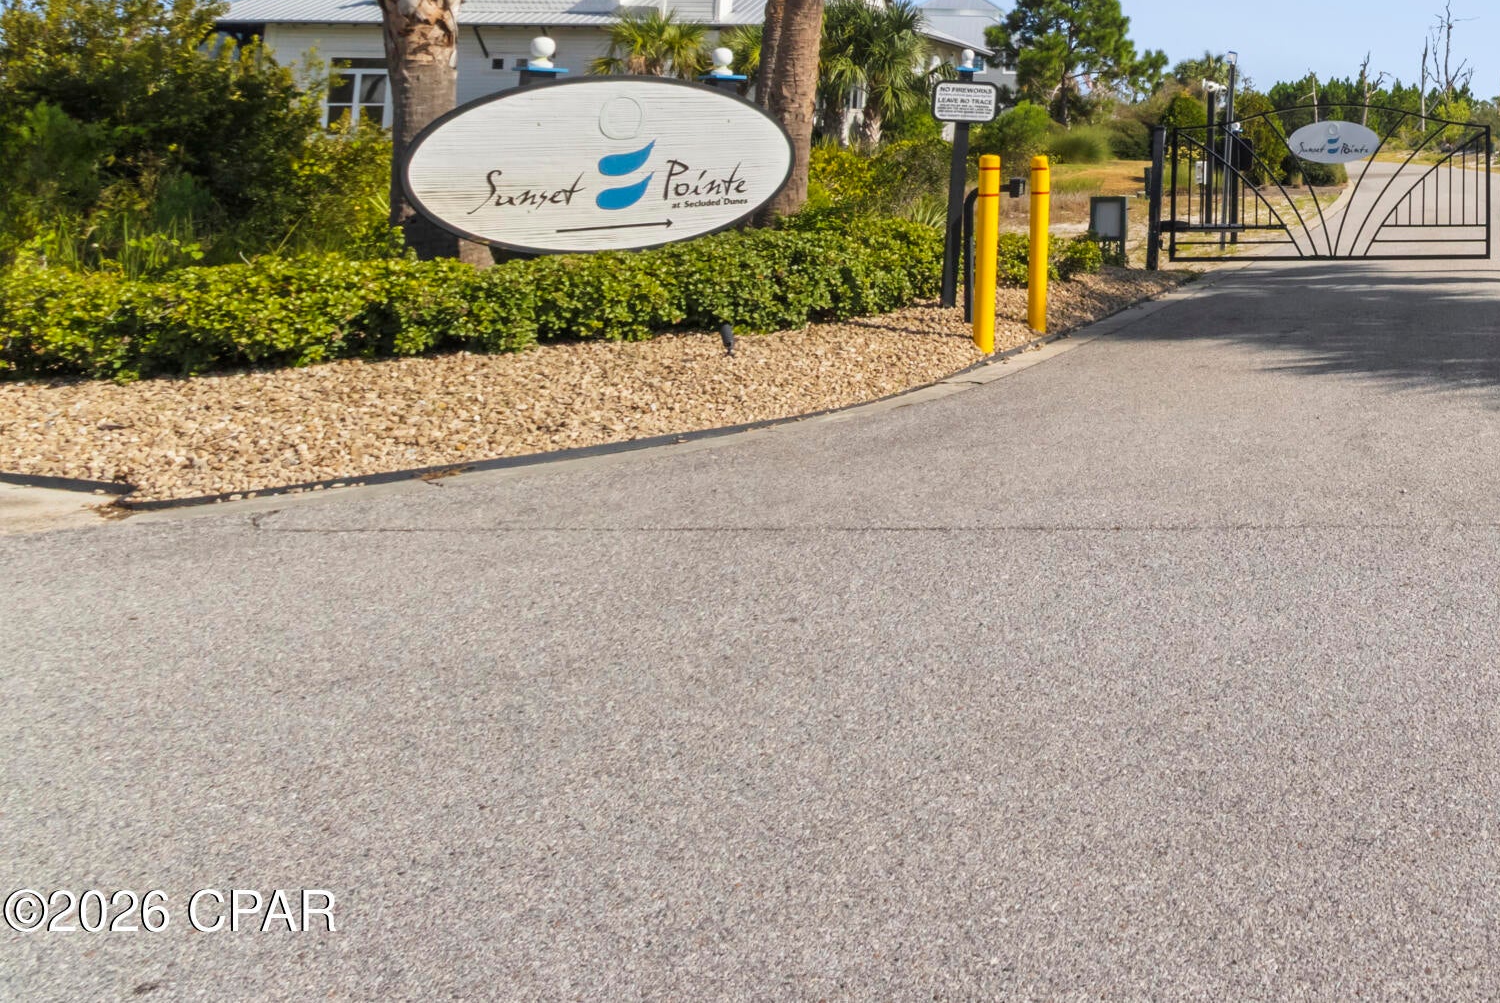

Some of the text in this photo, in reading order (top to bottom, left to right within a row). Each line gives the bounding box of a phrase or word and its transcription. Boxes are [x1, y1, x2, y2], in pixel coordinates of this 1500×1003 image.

[1298, 141, 1369, 155] Sunset Pointe
[467, 159, 748, 215] Sunset Pointe
[684, 199, 721, 208] Secluded
[724, 197, 748, 205] Dunes
